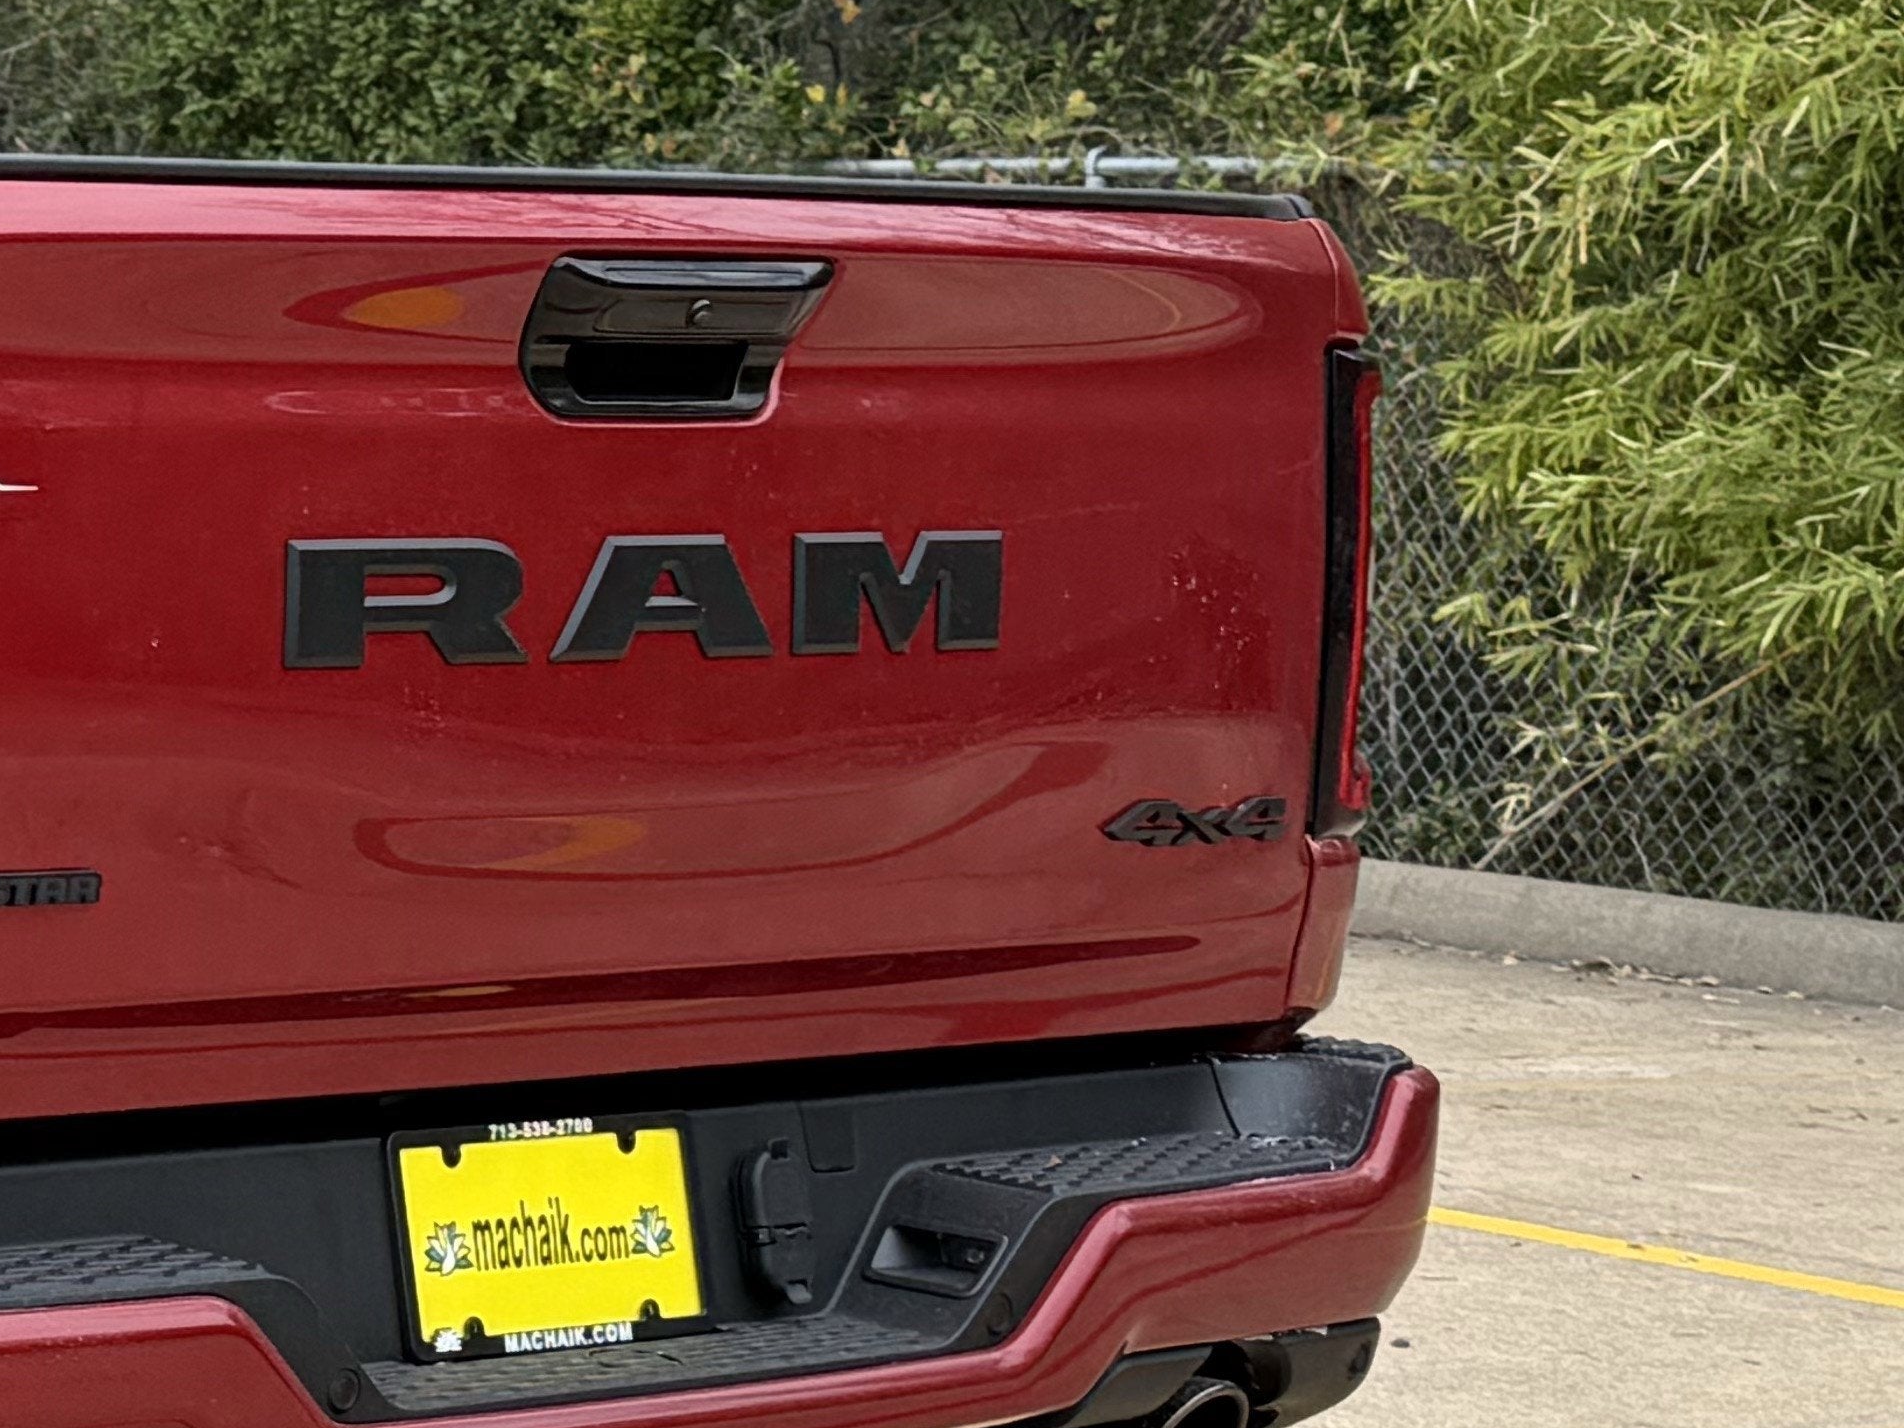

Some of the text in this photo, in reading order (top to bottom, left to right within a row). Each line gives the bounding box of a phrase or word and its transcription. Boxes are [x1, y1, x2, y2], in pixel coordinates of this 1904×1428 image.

[284, 530, 1003, 668] RAM
[1098, 796, 1287, 847] 4x4
[472, 1196, 630, 1272] machaik.com
[503, 1322, 634, 1354] MACHAIK.COM
